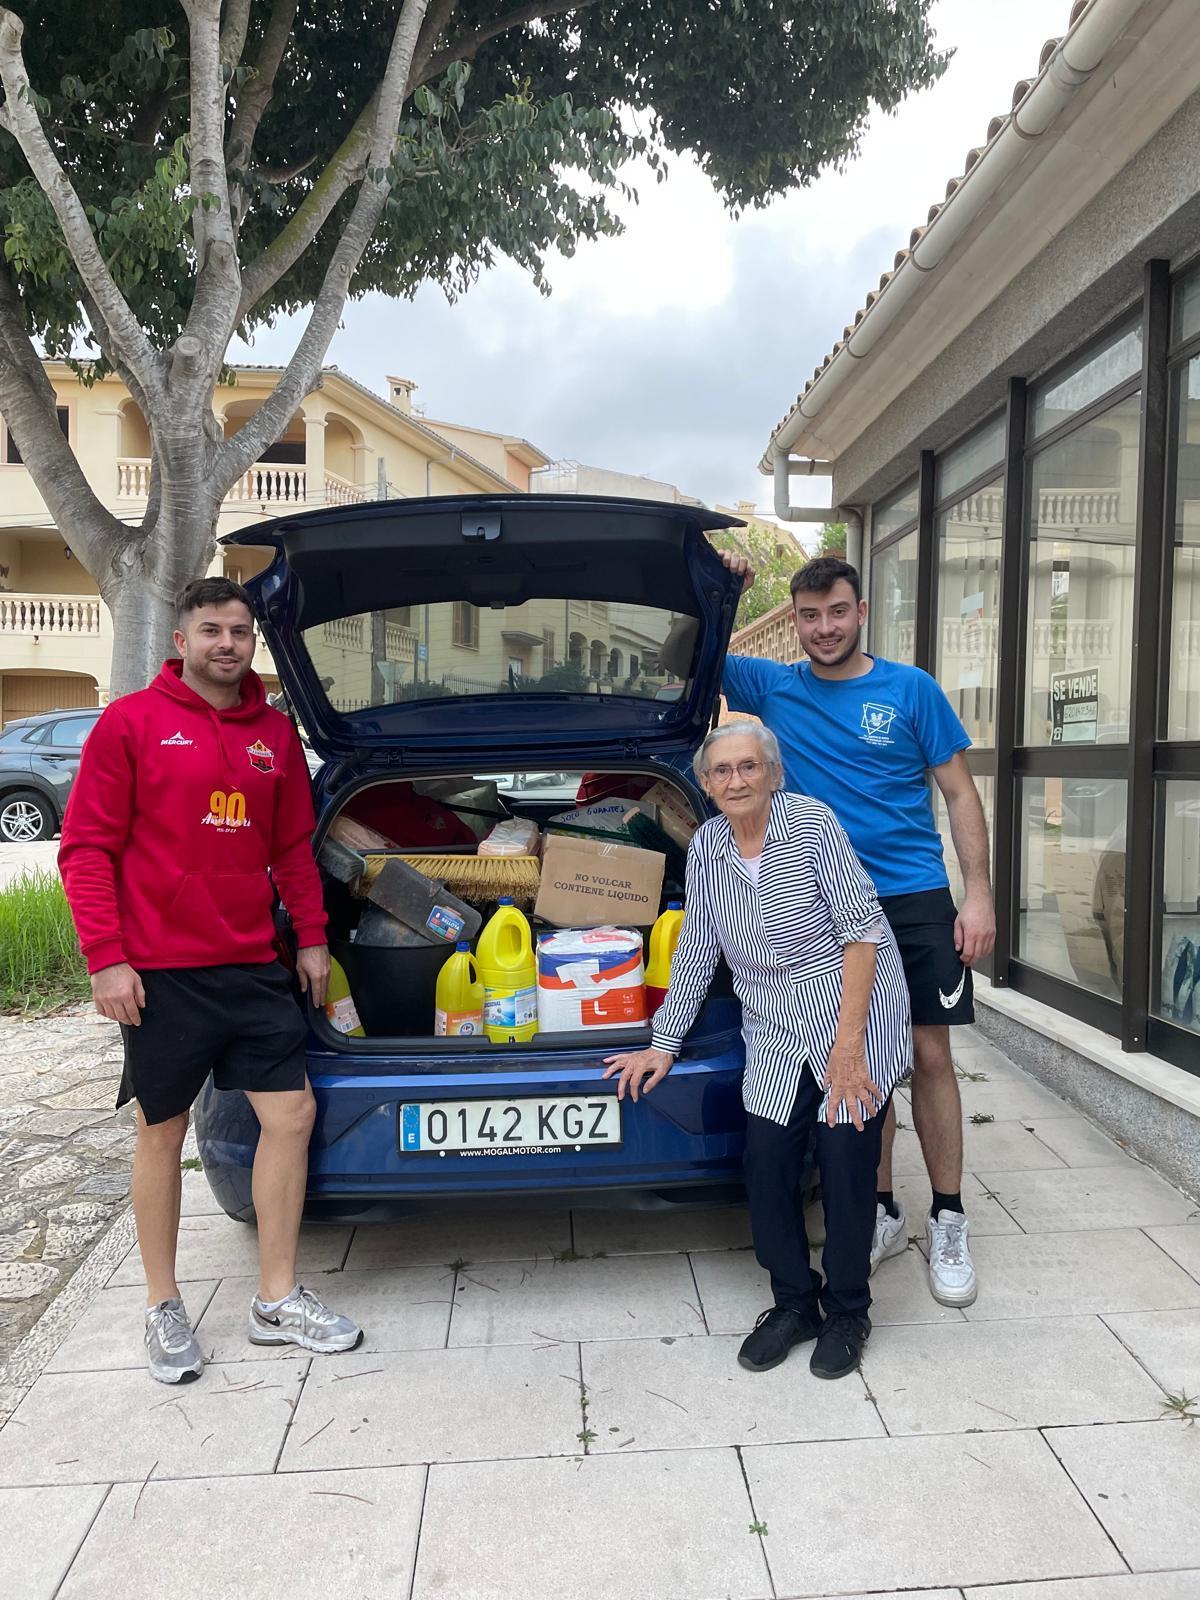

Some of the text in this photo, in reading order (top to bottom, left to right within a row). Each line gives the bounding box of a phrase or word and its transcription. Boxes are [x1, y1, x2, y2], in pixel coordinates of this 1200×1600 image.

[1053, 674, 1097, 702] SE VENDE
[210, 790, 246, 827] 90
[554, 881, 649, 903] CONTIENE LIQUIDO
[575, 873, 632, 889] NO VOLCAR
[427, 1103, 609, 1144] 0142 KGZ
[408, 1133, 415, 1144] E
[460, 1146, 562, 1157] www.MOGALMOTOR.com
